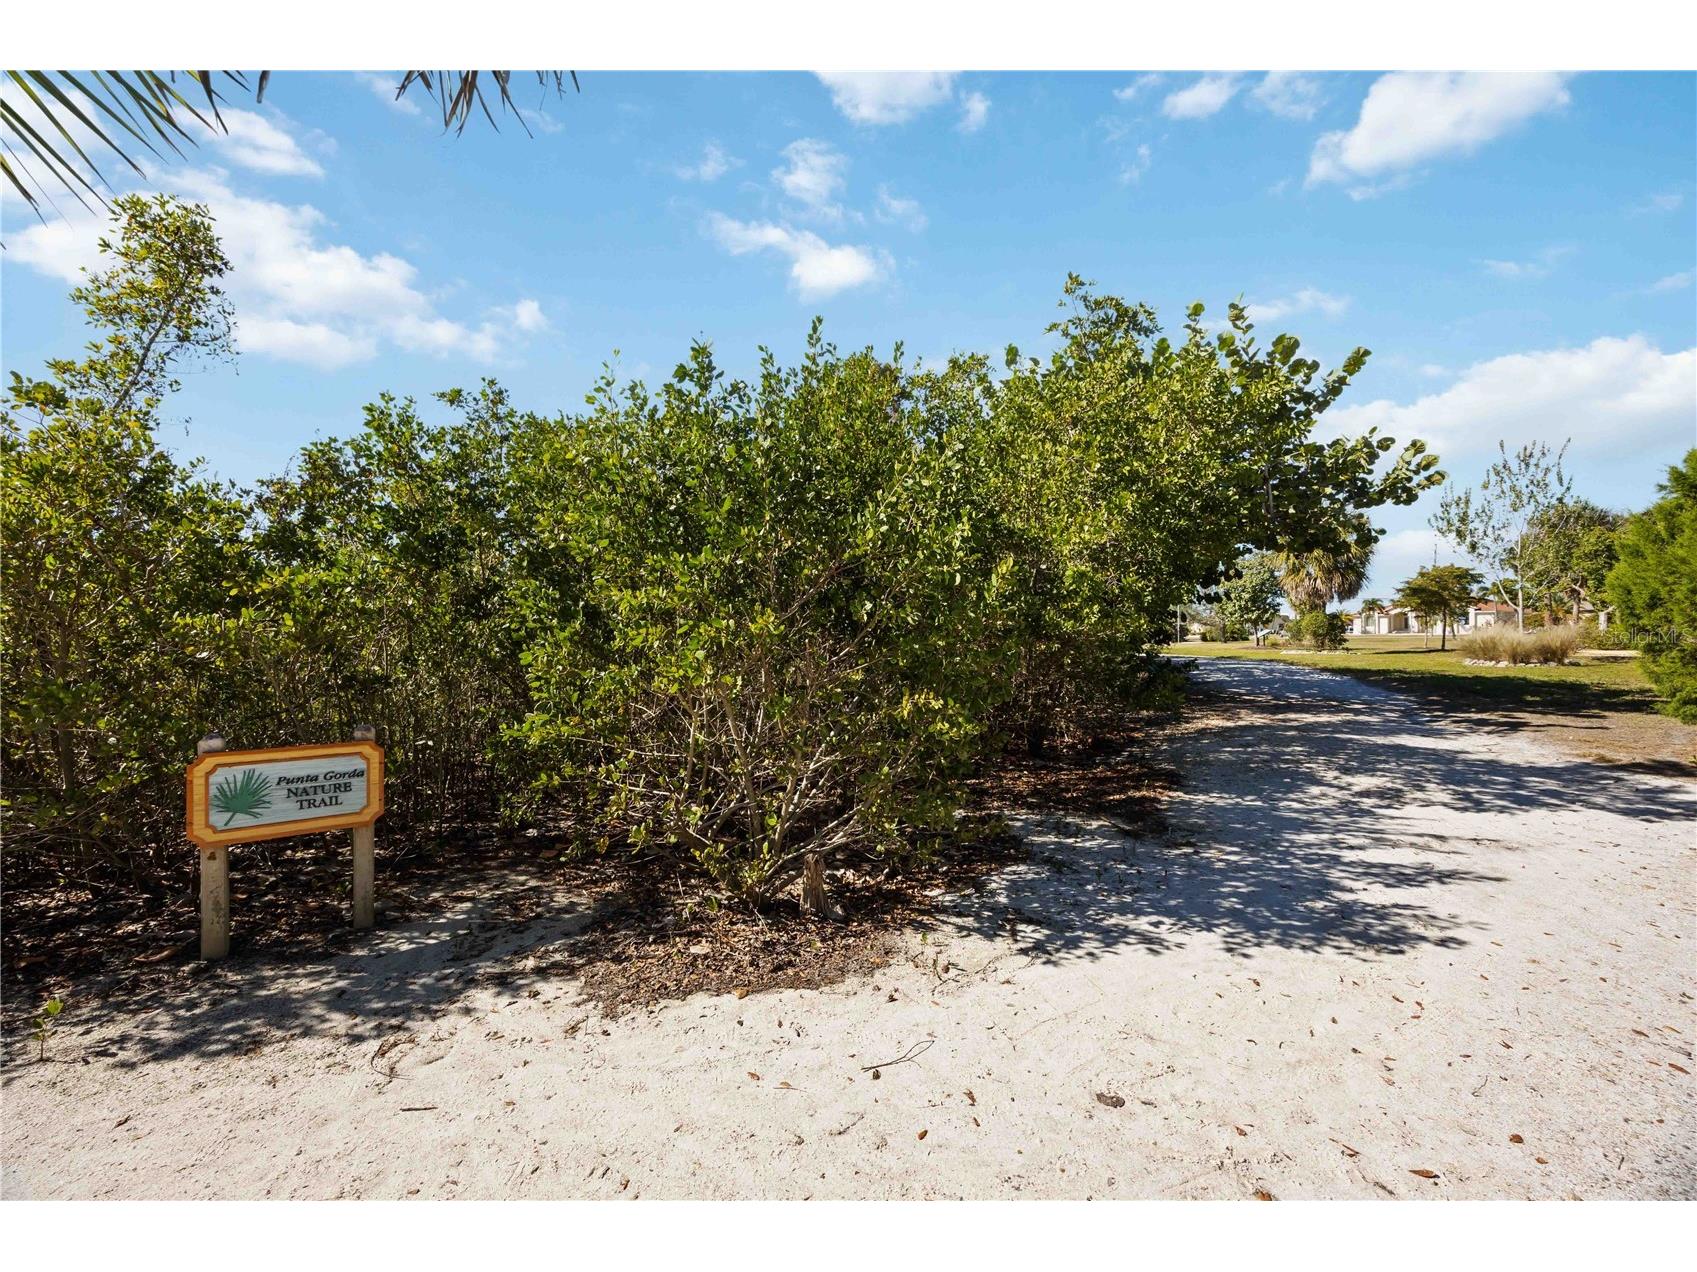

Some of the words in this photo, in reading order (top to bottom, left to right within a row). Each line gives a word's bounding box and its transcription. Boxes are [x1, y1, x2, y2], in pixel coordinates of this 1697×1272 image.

[276, 775, 319, 785] Punta
[323, 769, 365, 780] Gorda
[286, 781, 352, 798] NATURE
[296, 795, 343, 810] TRAIL
